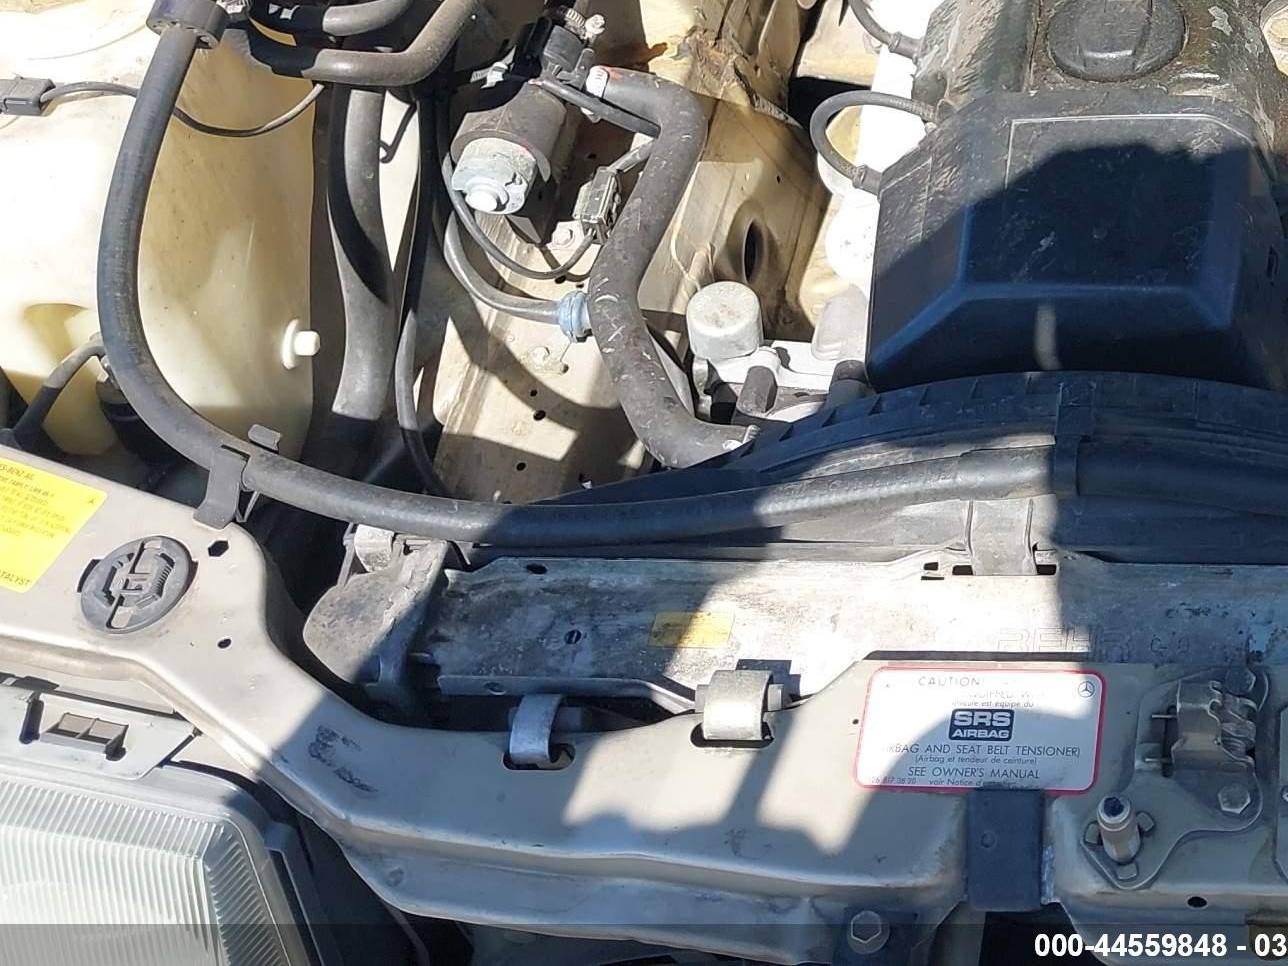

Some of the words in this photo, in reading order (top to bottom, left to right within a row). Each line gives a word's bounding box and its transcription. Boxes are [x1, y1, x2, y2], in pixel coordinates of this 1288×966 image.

[953, 711, 1012, 727] SRS
[952, 729, 1010, 739] AIRBAG
[925, 744, 950, 754] AND
[956, 744, 982, 755] SEAT
[987, 745, 1010, 756] BELT
[1016, 745, 1081, 757] TENSIONER)
[947, 755, 955, 763] et
[990, 755, 1001, 763] de
[908, 766, 927, 777] SEE
[932, 767, 985, 777] OWNER'S
[990, 767, 1041, 779] MANUAL
